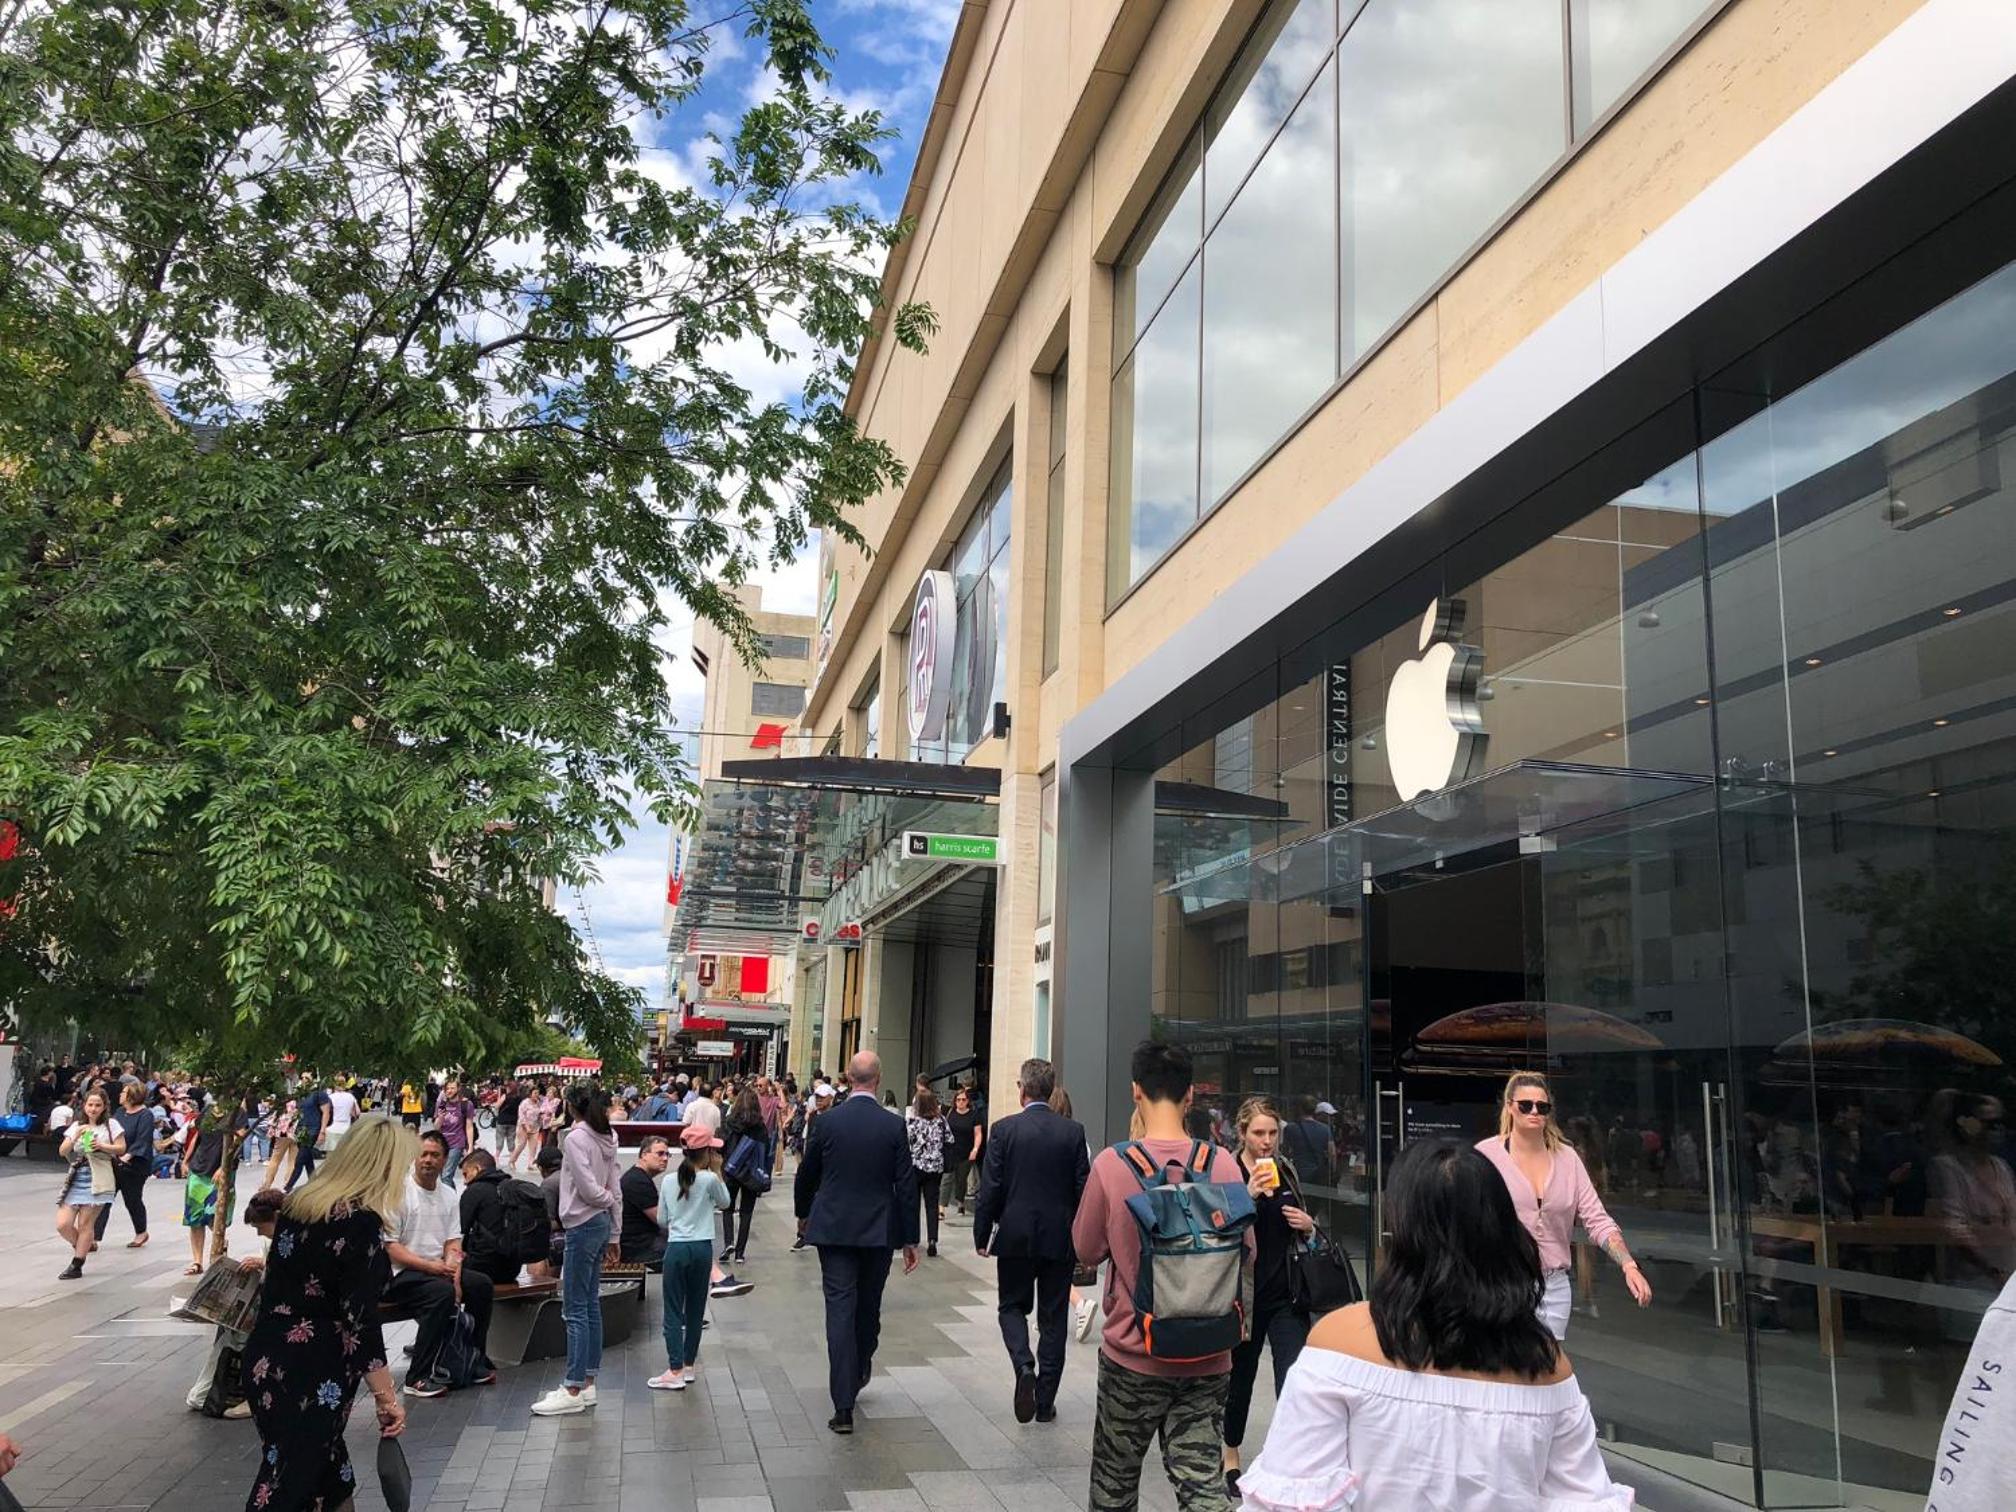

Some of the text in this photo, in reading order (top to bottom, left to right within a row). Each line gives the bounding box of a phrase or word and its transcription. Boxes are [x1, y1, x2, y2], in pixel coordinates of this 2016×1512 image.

[934, 841, 961, 853] harris
[962, 843, 990, 854] scarfe
[1939, 1360, 2002, 1486] SAILING
